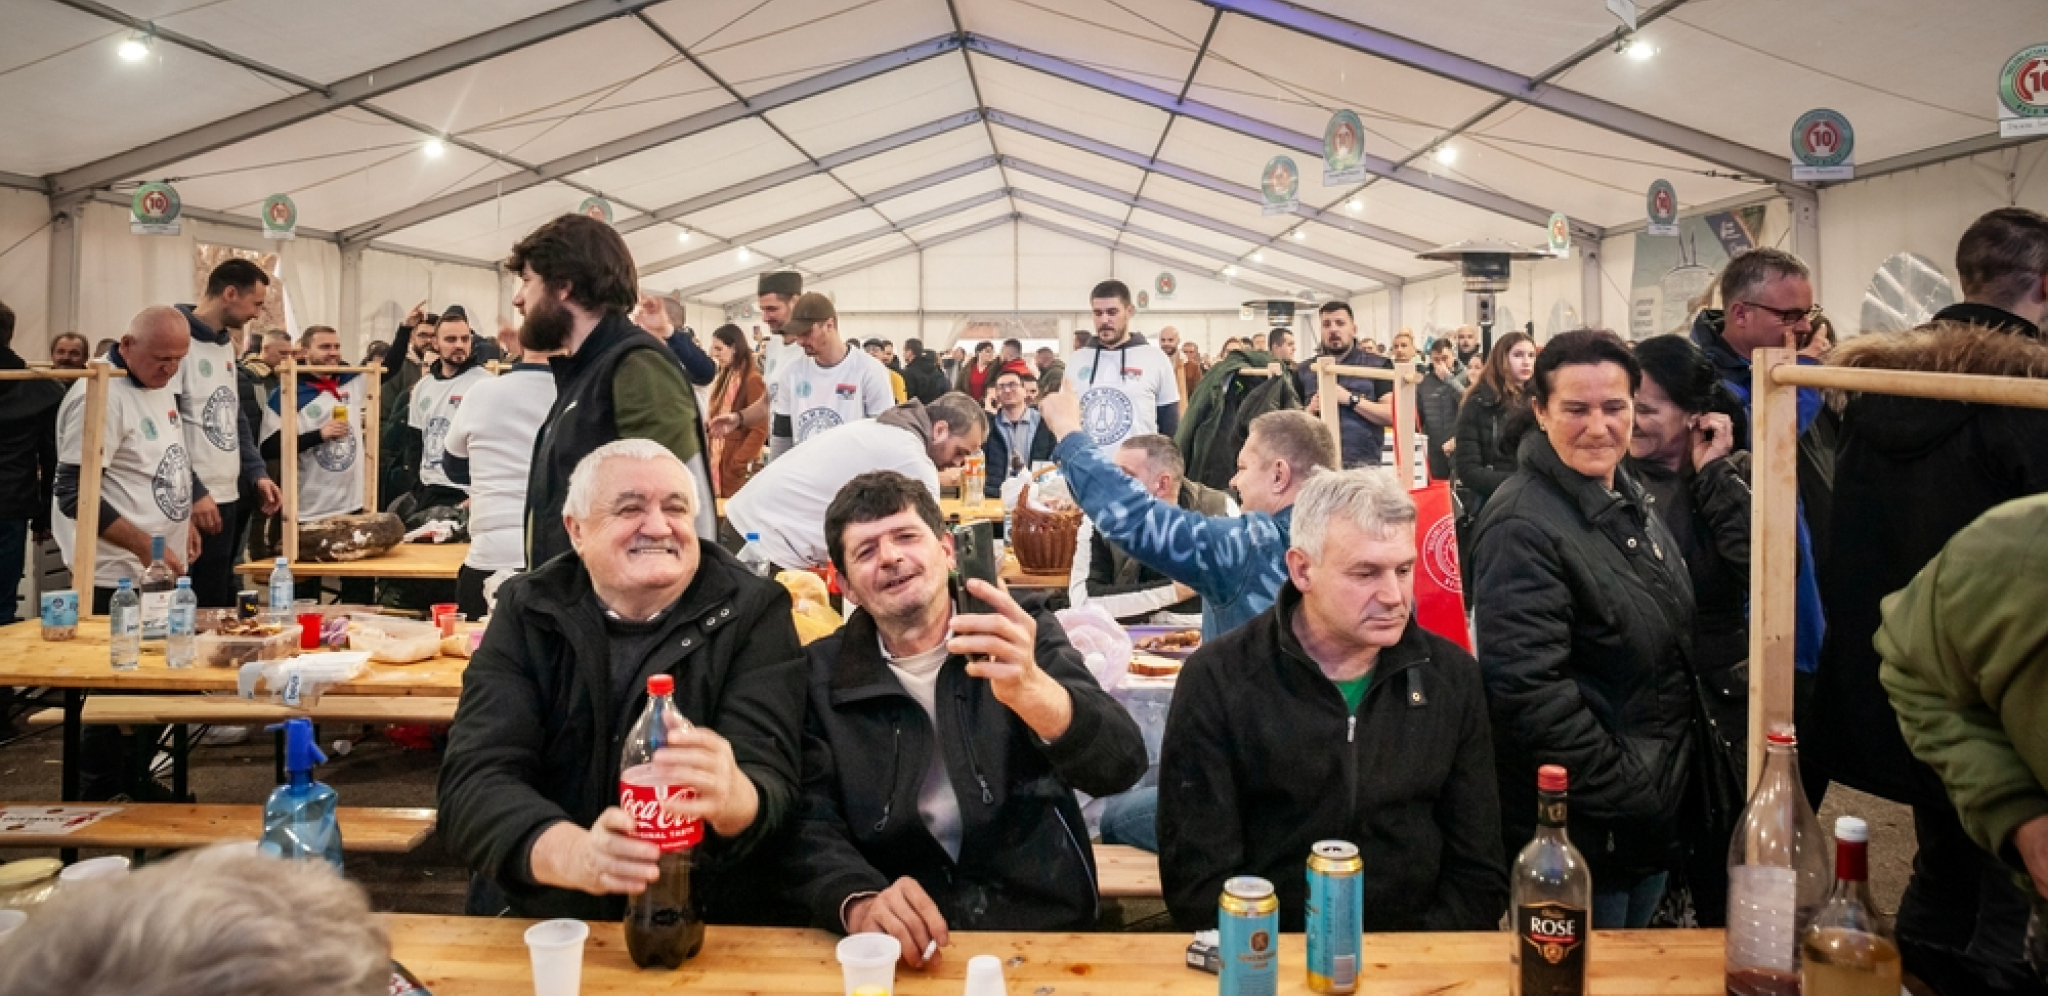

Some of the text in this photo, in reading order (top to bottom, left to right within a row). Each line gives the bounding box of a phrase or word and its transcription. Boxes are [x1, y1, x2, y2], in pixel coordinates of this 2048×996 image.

[1813, 131, 1832, 147] 10
[149, 198, 163, 210] 10
[1531, 915, 1576, 936] ROSE
